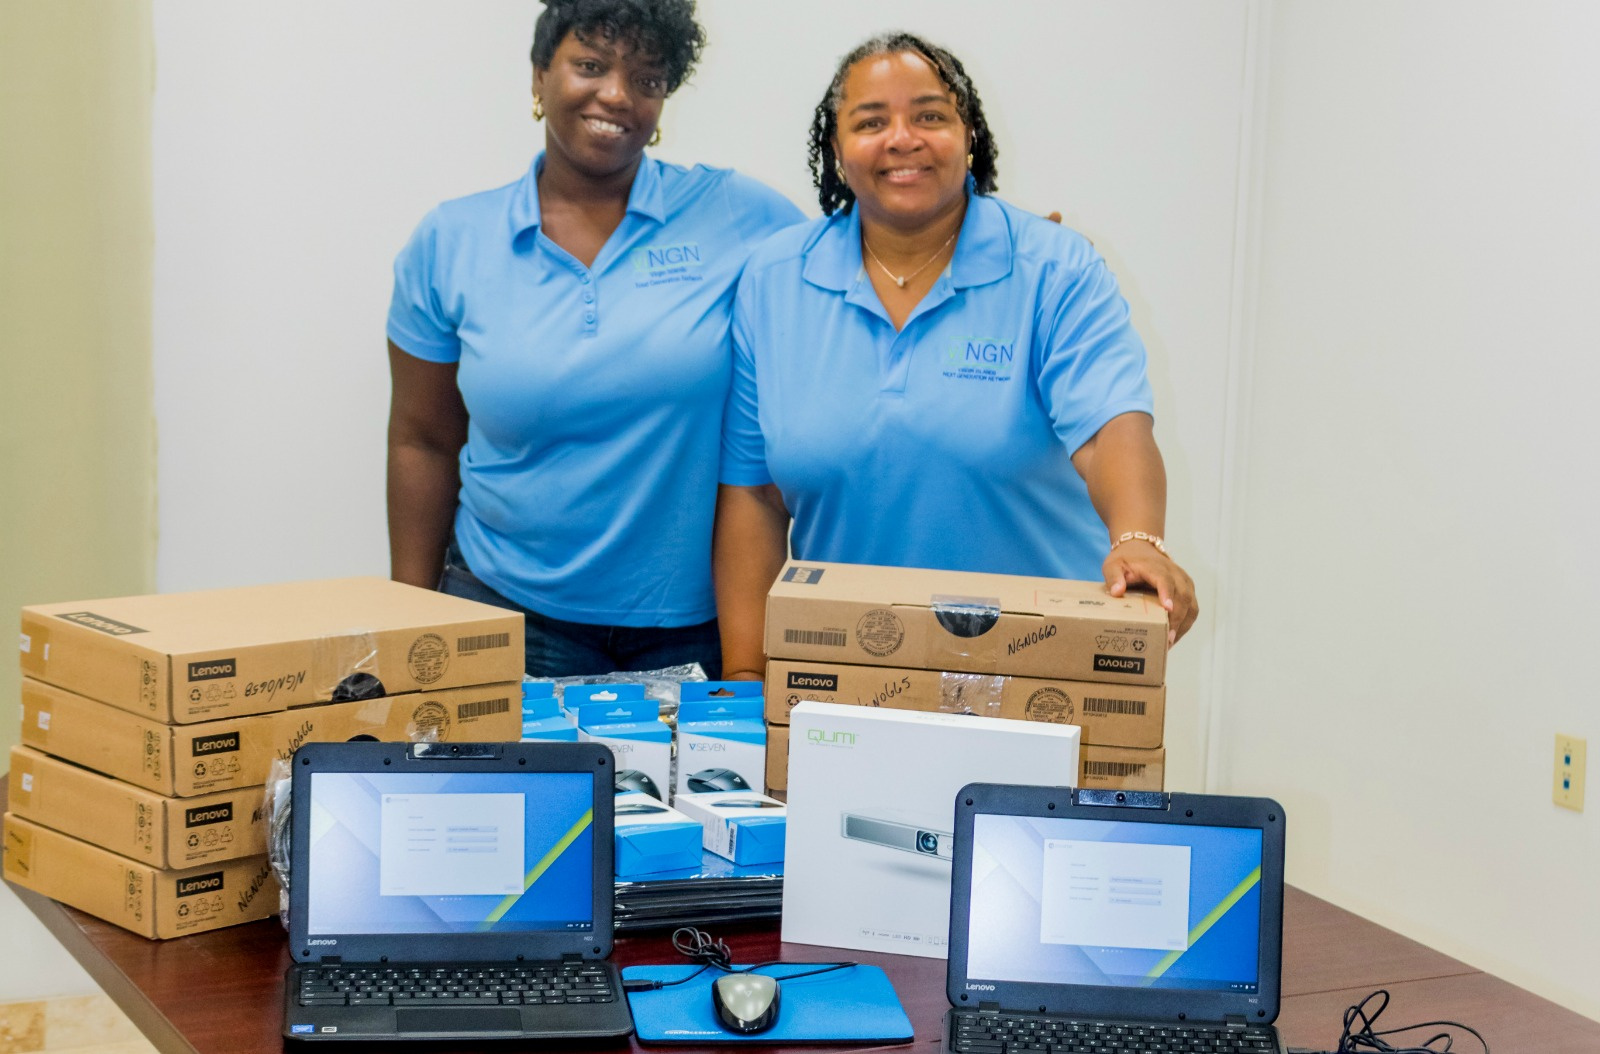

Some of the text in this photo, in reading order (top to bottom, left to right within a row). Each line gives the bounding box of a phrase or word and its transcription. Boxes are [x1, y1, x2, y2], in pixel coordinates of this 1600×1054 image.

[191, 663, 233, 677] Lenovo
[1098, 658, 1141, 671] Lenovo
[791, 675, 834, 688] Lenovo
[196, 738, 236, 752] Lenovo
[189, 808, 229, 823] Lenovo
[180, 877, 220, 893] Lenovo
[965, 983, 996, 991] Lenovo
